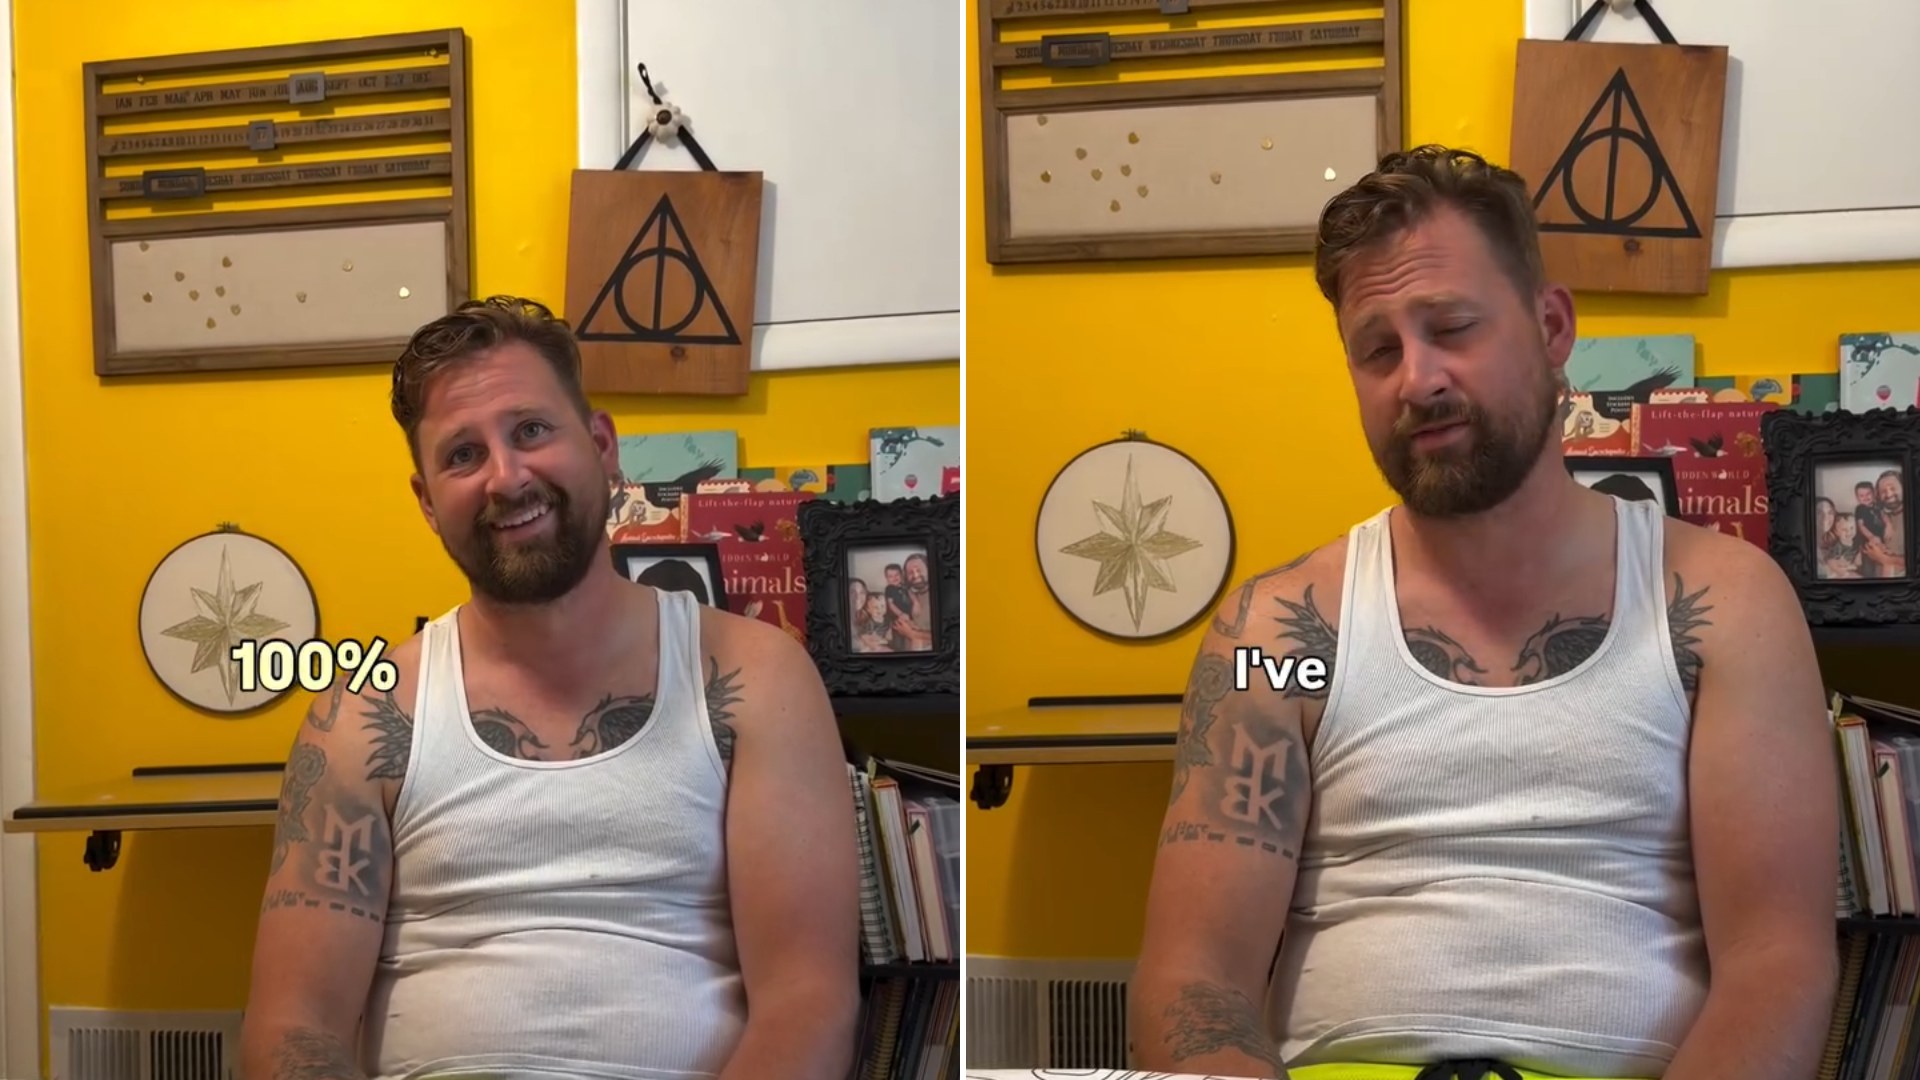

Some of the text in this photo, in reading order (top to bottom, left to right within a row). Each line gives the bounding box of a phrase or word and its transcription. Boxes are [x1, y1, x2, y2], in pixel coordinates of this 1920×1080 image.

[1212, 33, 1262, 48] THURSDAY
[1268, 30, 1303, 43] FRIDAY
[1310, 26, 1360, 41] SATURDAY
[115, 96, 132, 109] JAN
[139, 94, 158, 107] FEB
[165, 92, 188, 104] MAR
[193, 91, 213, 103] APR
[220, 89, 241, 100] MAY
[296, 79, 318, 96] AUG
[359, 76, 378, 89] OCT
[298, 165, 341, 180] THURSDAY
[348, 163, 378, 175] FRIDAY
[385, 160, 431, 172] SATURDAY
[1651, 410, 1724, 420] Lift-the-flap
[1677, 470, 1708, 480] IDDEN
[698, 499, 802, 508] Lift-the-flap natur
[722, 553, 752, 562] IDDEN
